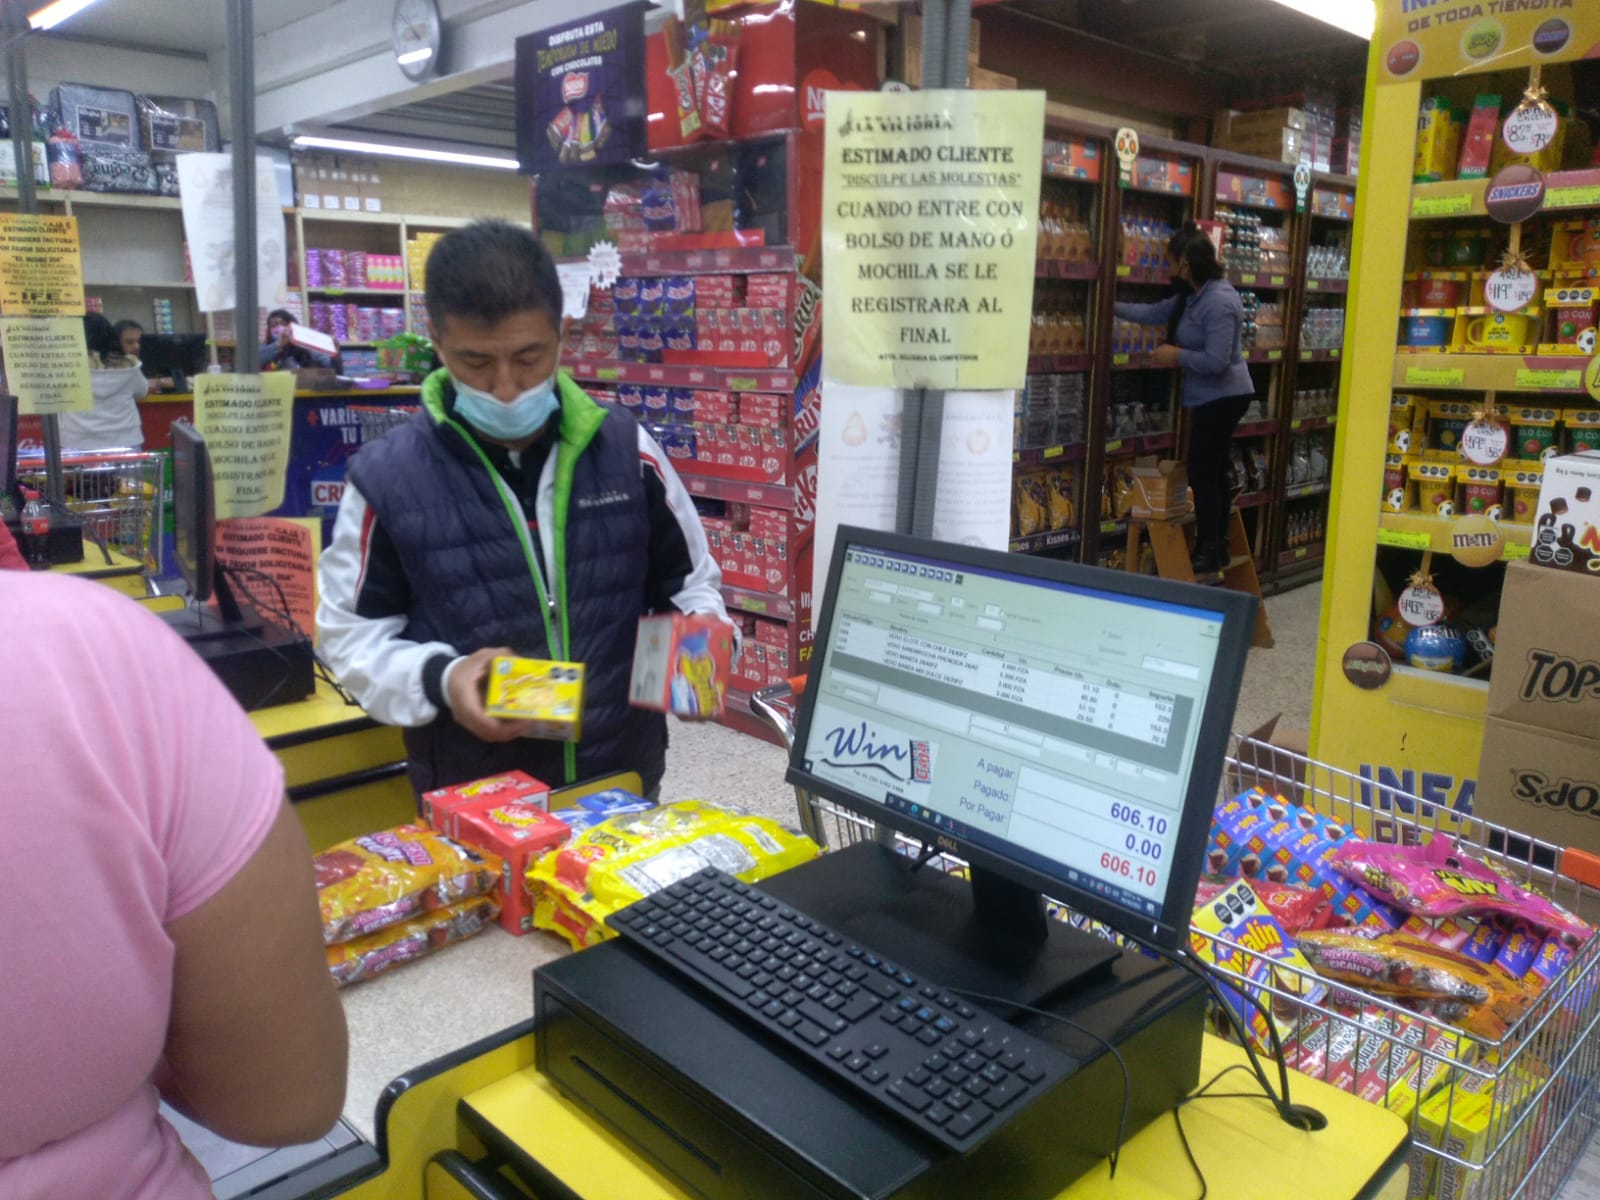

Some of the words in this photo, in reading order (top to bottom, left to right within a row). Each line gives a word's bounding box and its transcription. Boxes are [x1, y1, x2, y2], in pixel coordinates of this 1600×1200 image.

[1407, 17, 1431, 33] DE
[1435, 4, 1484, 25] TODA
[548, 26, 584, 47] DISFRUTA
[584, 20, 605, 36] ESTA
[842, 146, 932, 165] ESTIMADO
[936, 144, 1014, 164] CLIENTE
[910, 171, 937, 186] LAS
[1490, 183, 1540, 201] SNICKERS
[836, 200, 913, 219] CUANDO
[917, 199, 982, 217] ENTRE
[985, 199, 1025, 217] CON
[845, 232, 905, 250] BOLSO
[909, 231, 934, 249] DE
[939, 231, 996, 248] MANO
[857, 262, 939, 281] MOCHILA
[945, 262, 970, 280] SE
[974, 261, 999, 280] LE
[851, 296, 971, 315] REGISTRARA
[976, 296, 1004, 314] AL
[899, 327, 953, 345] FINAL
[825, 721, 908, 761] Win
[915, 741, 930, 782] Caja
[976, 757, 986, 769] A
[1110, 801, 1168, 836] 606.10
[959, 796, 976, 812] Por
[1099, 851, 1157, 887] 606.10
[1124, 833, 1162, 860] 0.00
